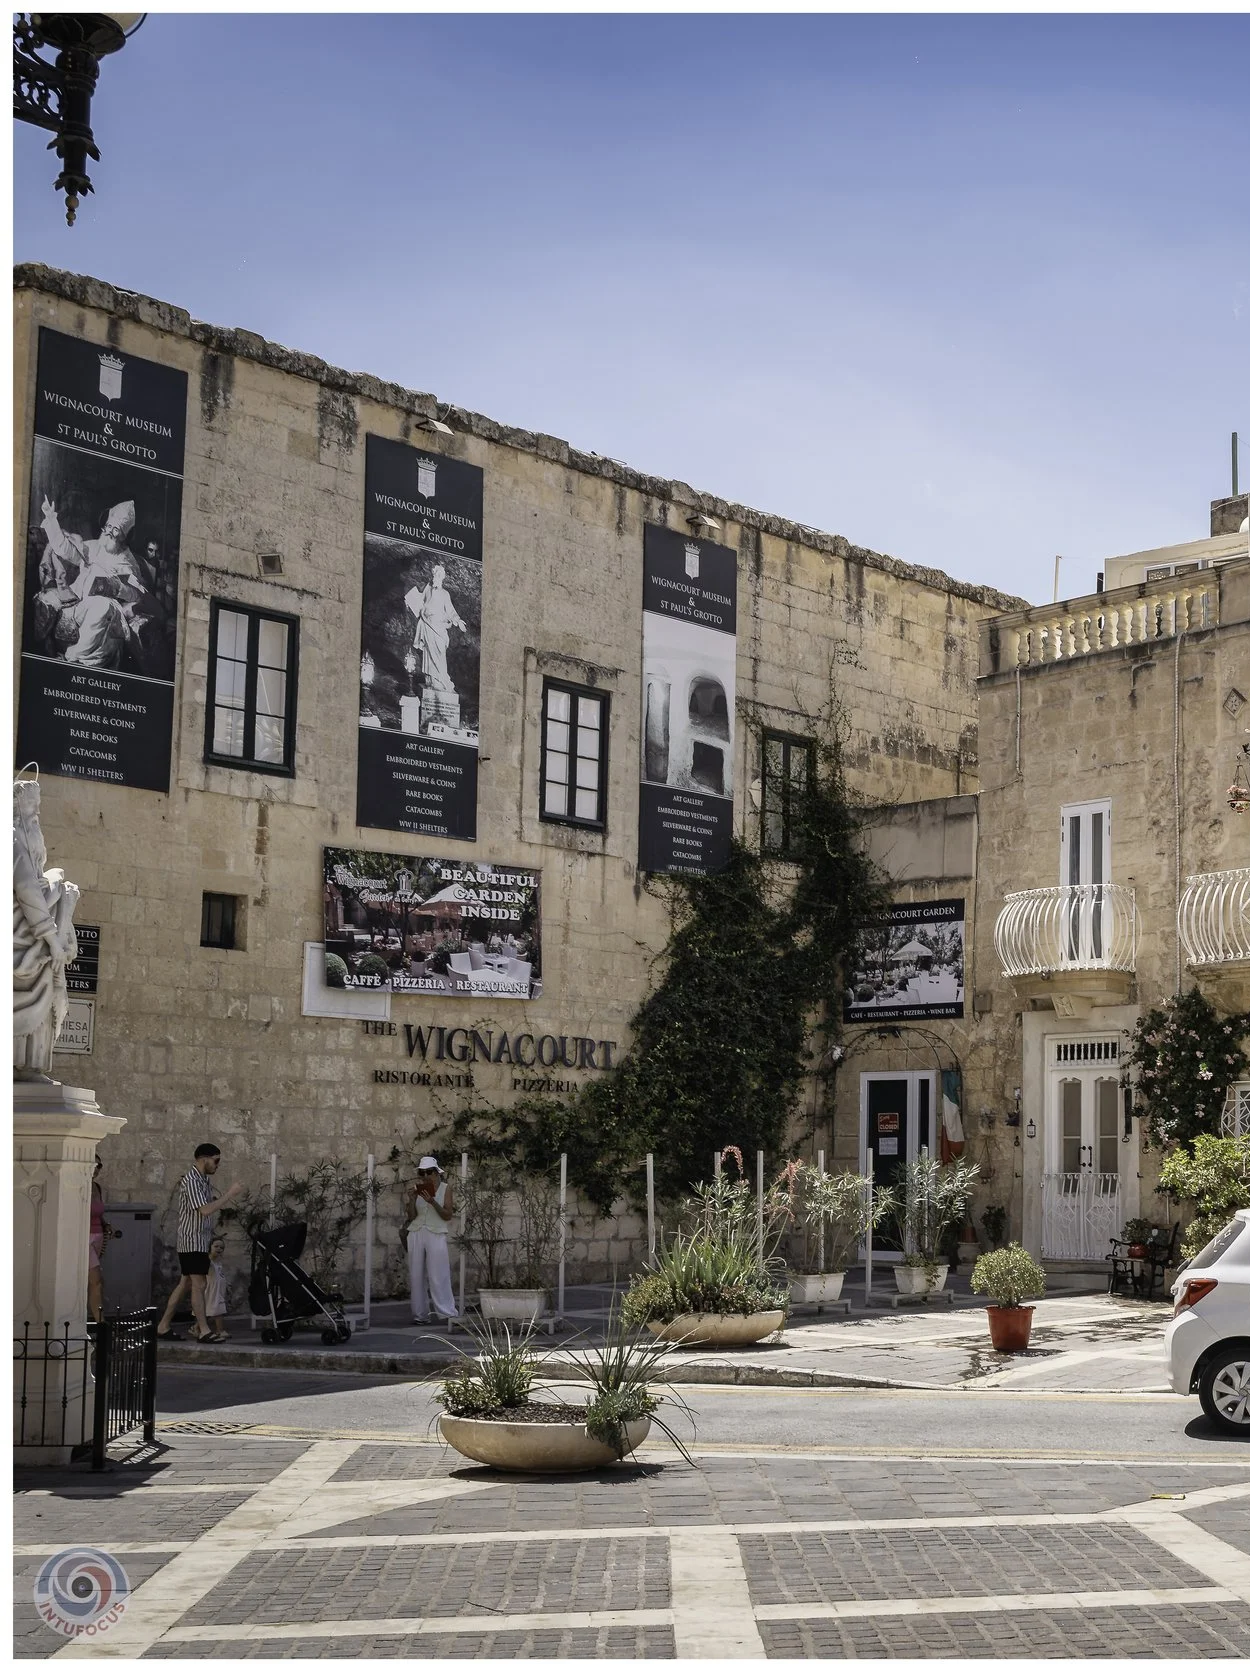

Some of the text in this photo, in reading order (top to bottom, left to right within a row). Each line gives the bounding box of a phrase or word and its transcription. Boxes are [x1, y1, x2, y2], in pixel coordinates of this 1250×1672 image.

[43, 389, 172, 438] WIGNACOURT MUSEUM
[103, 422, 114, 436] &
[57, 423, 157, 460] ST PAUL'S GROTTO
[375, 492, 476, 530] WIGNACOURT MUSEUM
[422, 518, 431, 530] &
[386, 520, 465, 550] ST PAUL'S GROTTO
[651, 575, 731, 606] WIGNACOURT MUSEUM
[688, 596, 695, 607] &
[660, 599, 723, 624] ST PAUL'S GROTTO
[71, 675, 121, 691] ART GALLERY
[43, 687, 147, 714] EMBROIDERED VESTMENTS
[53, 707, 136, 730] SILVERWARE & COINS
[70, 728, 118, 744] RARE BOOKS
[69, 746, 117, 762] CATACOMBS
[405, 742, 445, 756] ART GALLERY
[61, 763, 124, 780] WW II SHELTERS
[429, 762, 463, 775] VESTMENTS
[392, 771, 429, 784] SILVERWARE
[436, 779, 456, 789] COINS
[405, 789, 443, 802] RARE BOOKS
[683, 796, 704, 806] GALLERY
[405, 805, 442, 817] CATACOMBS
[691, 812, 718, 823] VESTMENTS
[399, 820, 412, 828] WW
[419, 823, 448, 833] SHELTERS
[662, 821, 692, 832] SILVERWARE
[697, 827, 713, 836] COINS
[672, 836, 703, 848] RARE BOOKS
[672, 850, 702, 861] CATACOMBS
[440, 868, 539, 889] BEAUTIFUL
[683, 866, 706, 876] SLTERS
[453, 889, 526, 905] GARDEN
[460, 905, 521, 921] INSIDE
[872, 909, 922, 920] GNACOURT
[923, 906, 956, 917] GARDEN
[343, 973, 529, 994] CAFFÈ PIZZERIA RESTAURANT
[867, 1010, 899, 1018] RESTAURANT
[61, 1021, 88, 1031] HIESA
[362, 1020, 617, 1071] THE WIGNACOURT
[373, 1069, 580, 1093] RISTORANTE PIZZERIA
